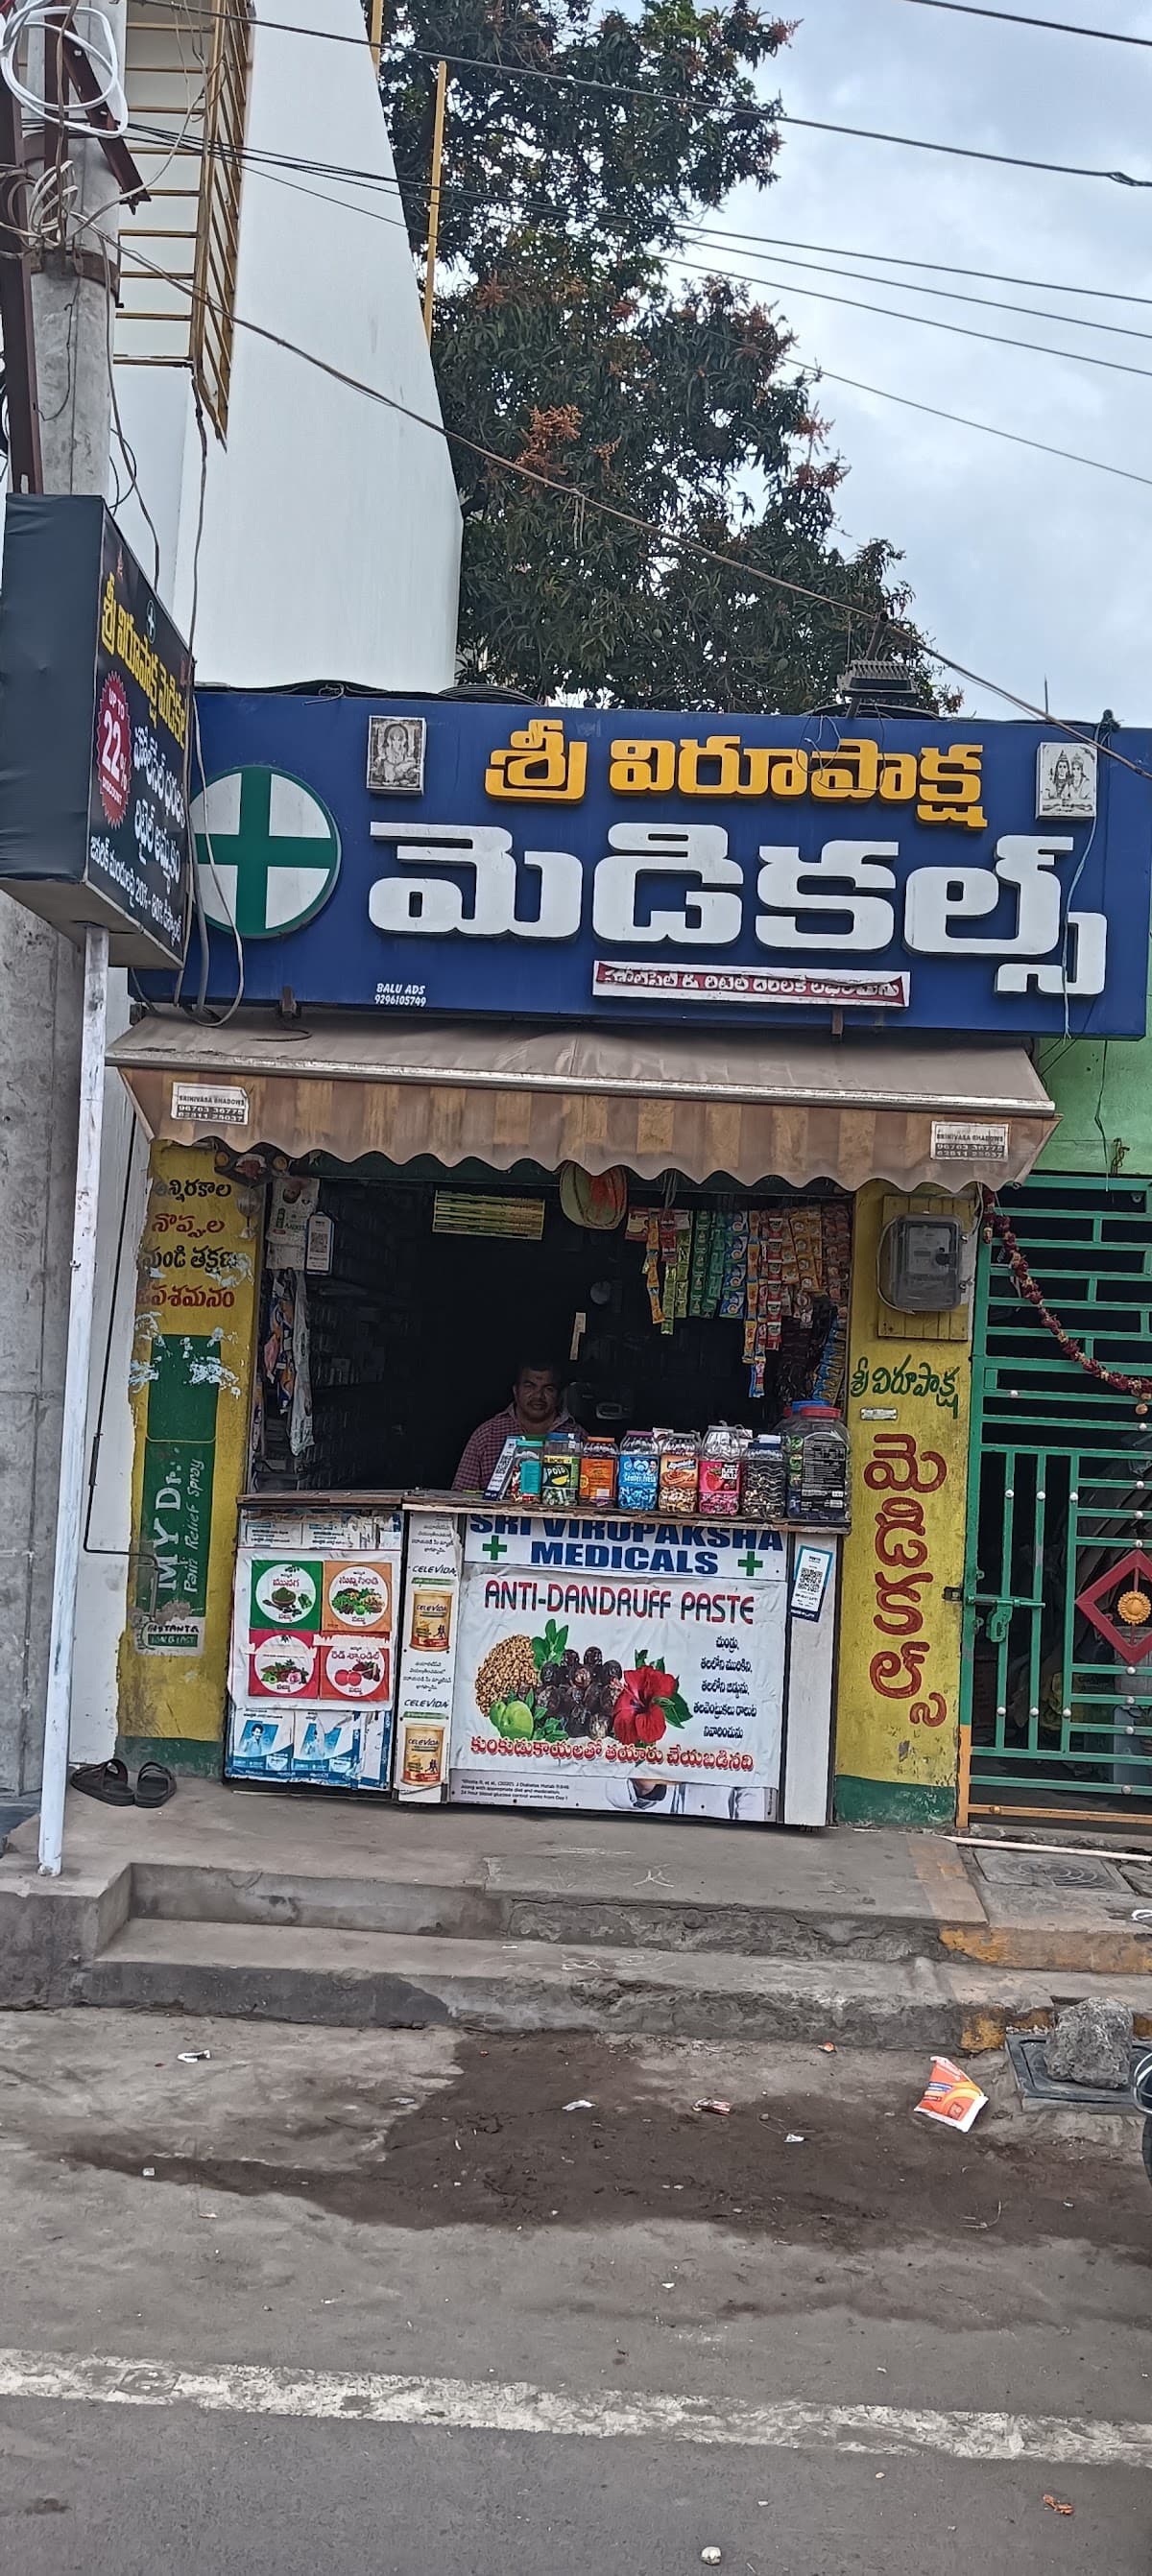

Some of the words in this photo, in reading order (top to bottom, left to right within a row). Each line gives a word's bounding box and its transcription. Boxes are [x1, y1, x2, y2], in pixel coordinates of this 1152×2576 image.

[101, 572, 116, 656] శ్రీ
[116, 604, 159, 729] విరూపాక్ష
[108, 687, 116, 709] UP
[116, 697, 126, 721] TO
[102, 709, 128, 792] 22%
[102, 775, 123, 806] DISCOUNT
[485, 719, 588, 803] శ్రీ
[610, 735, 988, 828] విరూపాక్ష
[369, 821, 1108, 995] మెడికల్స్
[374, 993, 427, 1008] 9296105749
[376, 983, 403, 994] BALU
[404, 984, 426, 995] ADS
[851, 1356, 870, 1397] శ్రీ
[872, 1354, 960, 1419] విరూపాక్ష
[186, 1458, 204, 1497] Spray
[183, 1506, 201, 1552] Relief
[541, 1517, 783, 1551] VIRUPAKSHA
[154, 1518, 180, 1590] MY
[530, 1540, 719, 1575] MEDICALS
[182, 1559, 199, 1593] Pain
[484, 1580, 672, 1619] ANTI-DANDRUFF
[681, 1591, 755, 1625] PASTE
[605, 1743, 664, 1766] తయారు
[666, 1746, 756, 1773] చేయబడినది
